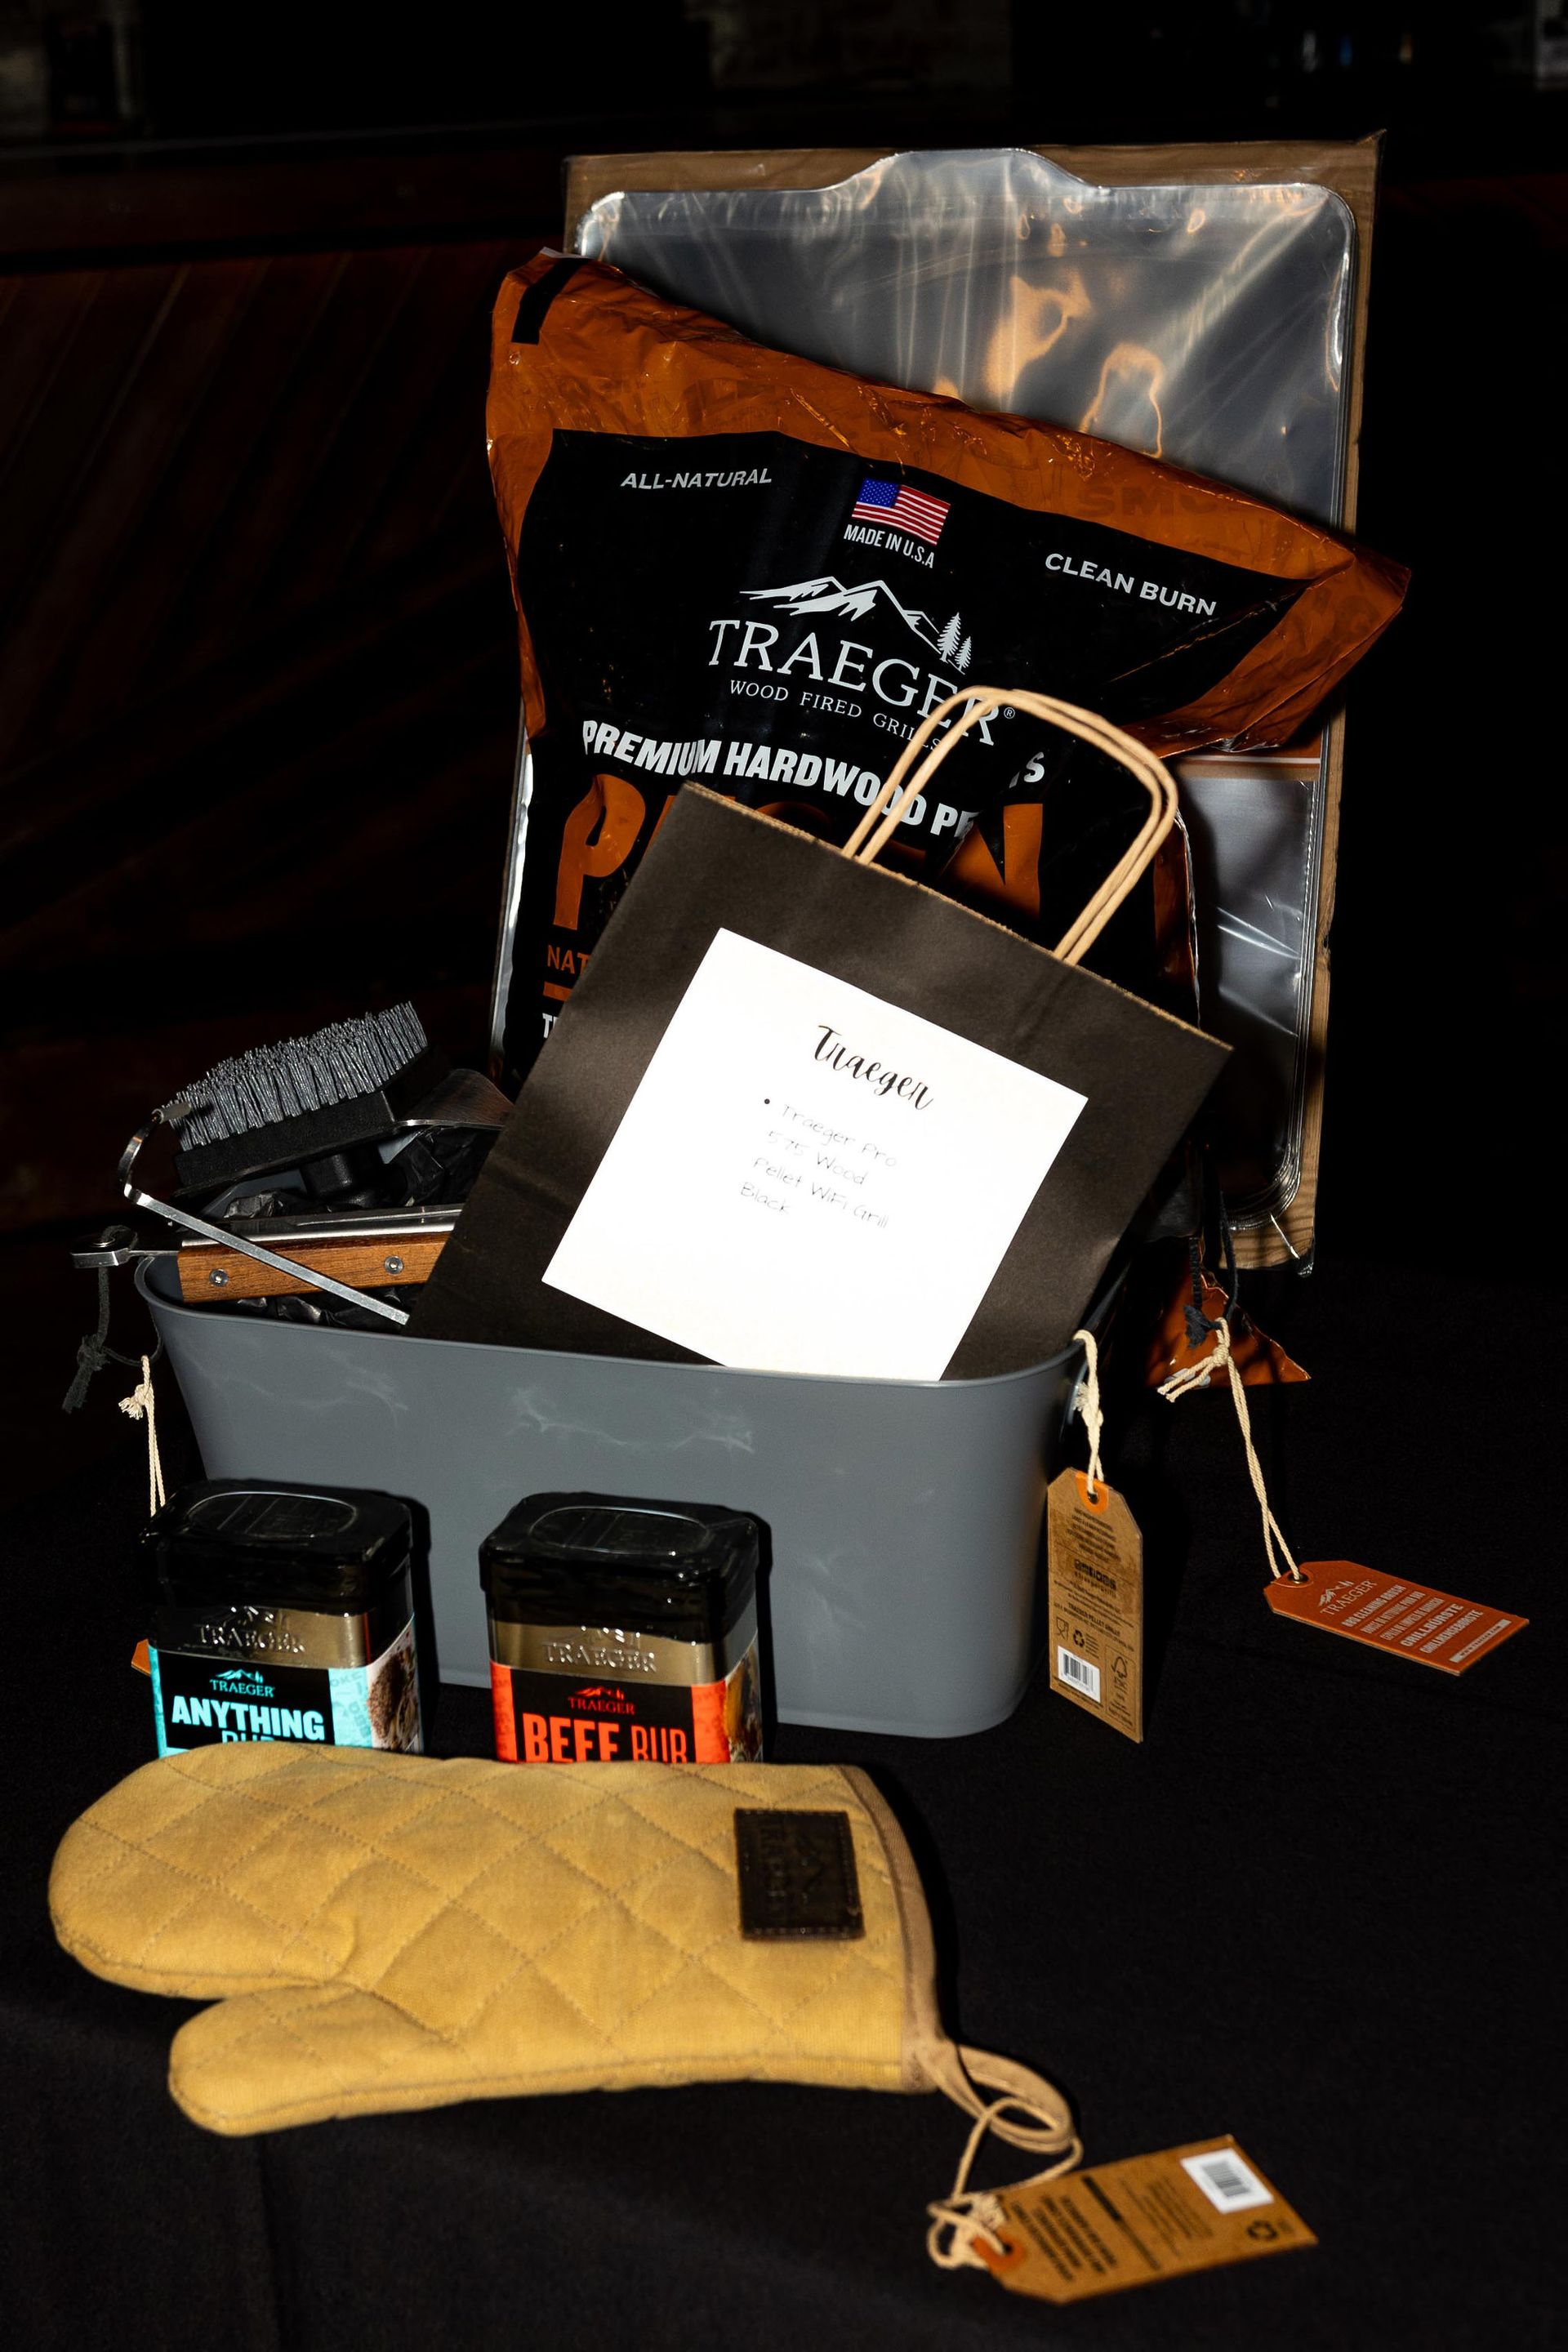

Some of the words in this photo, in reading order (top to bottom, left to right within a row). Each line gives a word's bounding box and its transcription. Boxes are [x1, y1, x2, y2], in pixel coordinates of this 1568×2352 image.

[621, 467, 773, 490] ALL-NATURAL
[844, 523, 884, 547] MADE
[885, 534, 902, 554] IN
[1045, 552, 1136, 594] CLEAN
[1139, 581, 1217, 617] BURN
[707, 619, 999, 746] TRAEGER
[728, 679, 790, 702] WOOD
[799, 691, 862, 718] FIRED
[872, 712, 942, 751] GRILS
[581, 719, 724, 777] PREMIUM
[813, 1023, 935, 1111] Traeger
[767, 1129, 809, 1156] 575
[816, 1151, 869, 1185] Wood
[782, 1103, 856, 1146] Traeger
[861, 1143, 898, 1168] Pro
[739, 1181, 791, 1214] Black
[752, 1156, 804, 1187] Pellet
[810, 1181, 848, 1210] WiFi
[853, 1204, 889, 1229] Grill
[1320, 1579, 1378, 1616] TRAEGER
[209, 1678, 275, 1698] TRAEGER
[568, 1696, 636, 1716] TRAEGER
[171, 1695, 326, 1741] ANYTHING
[522, 1712, 620, 1763] BEEF
[630, 1724, 688, 1763] RUB
